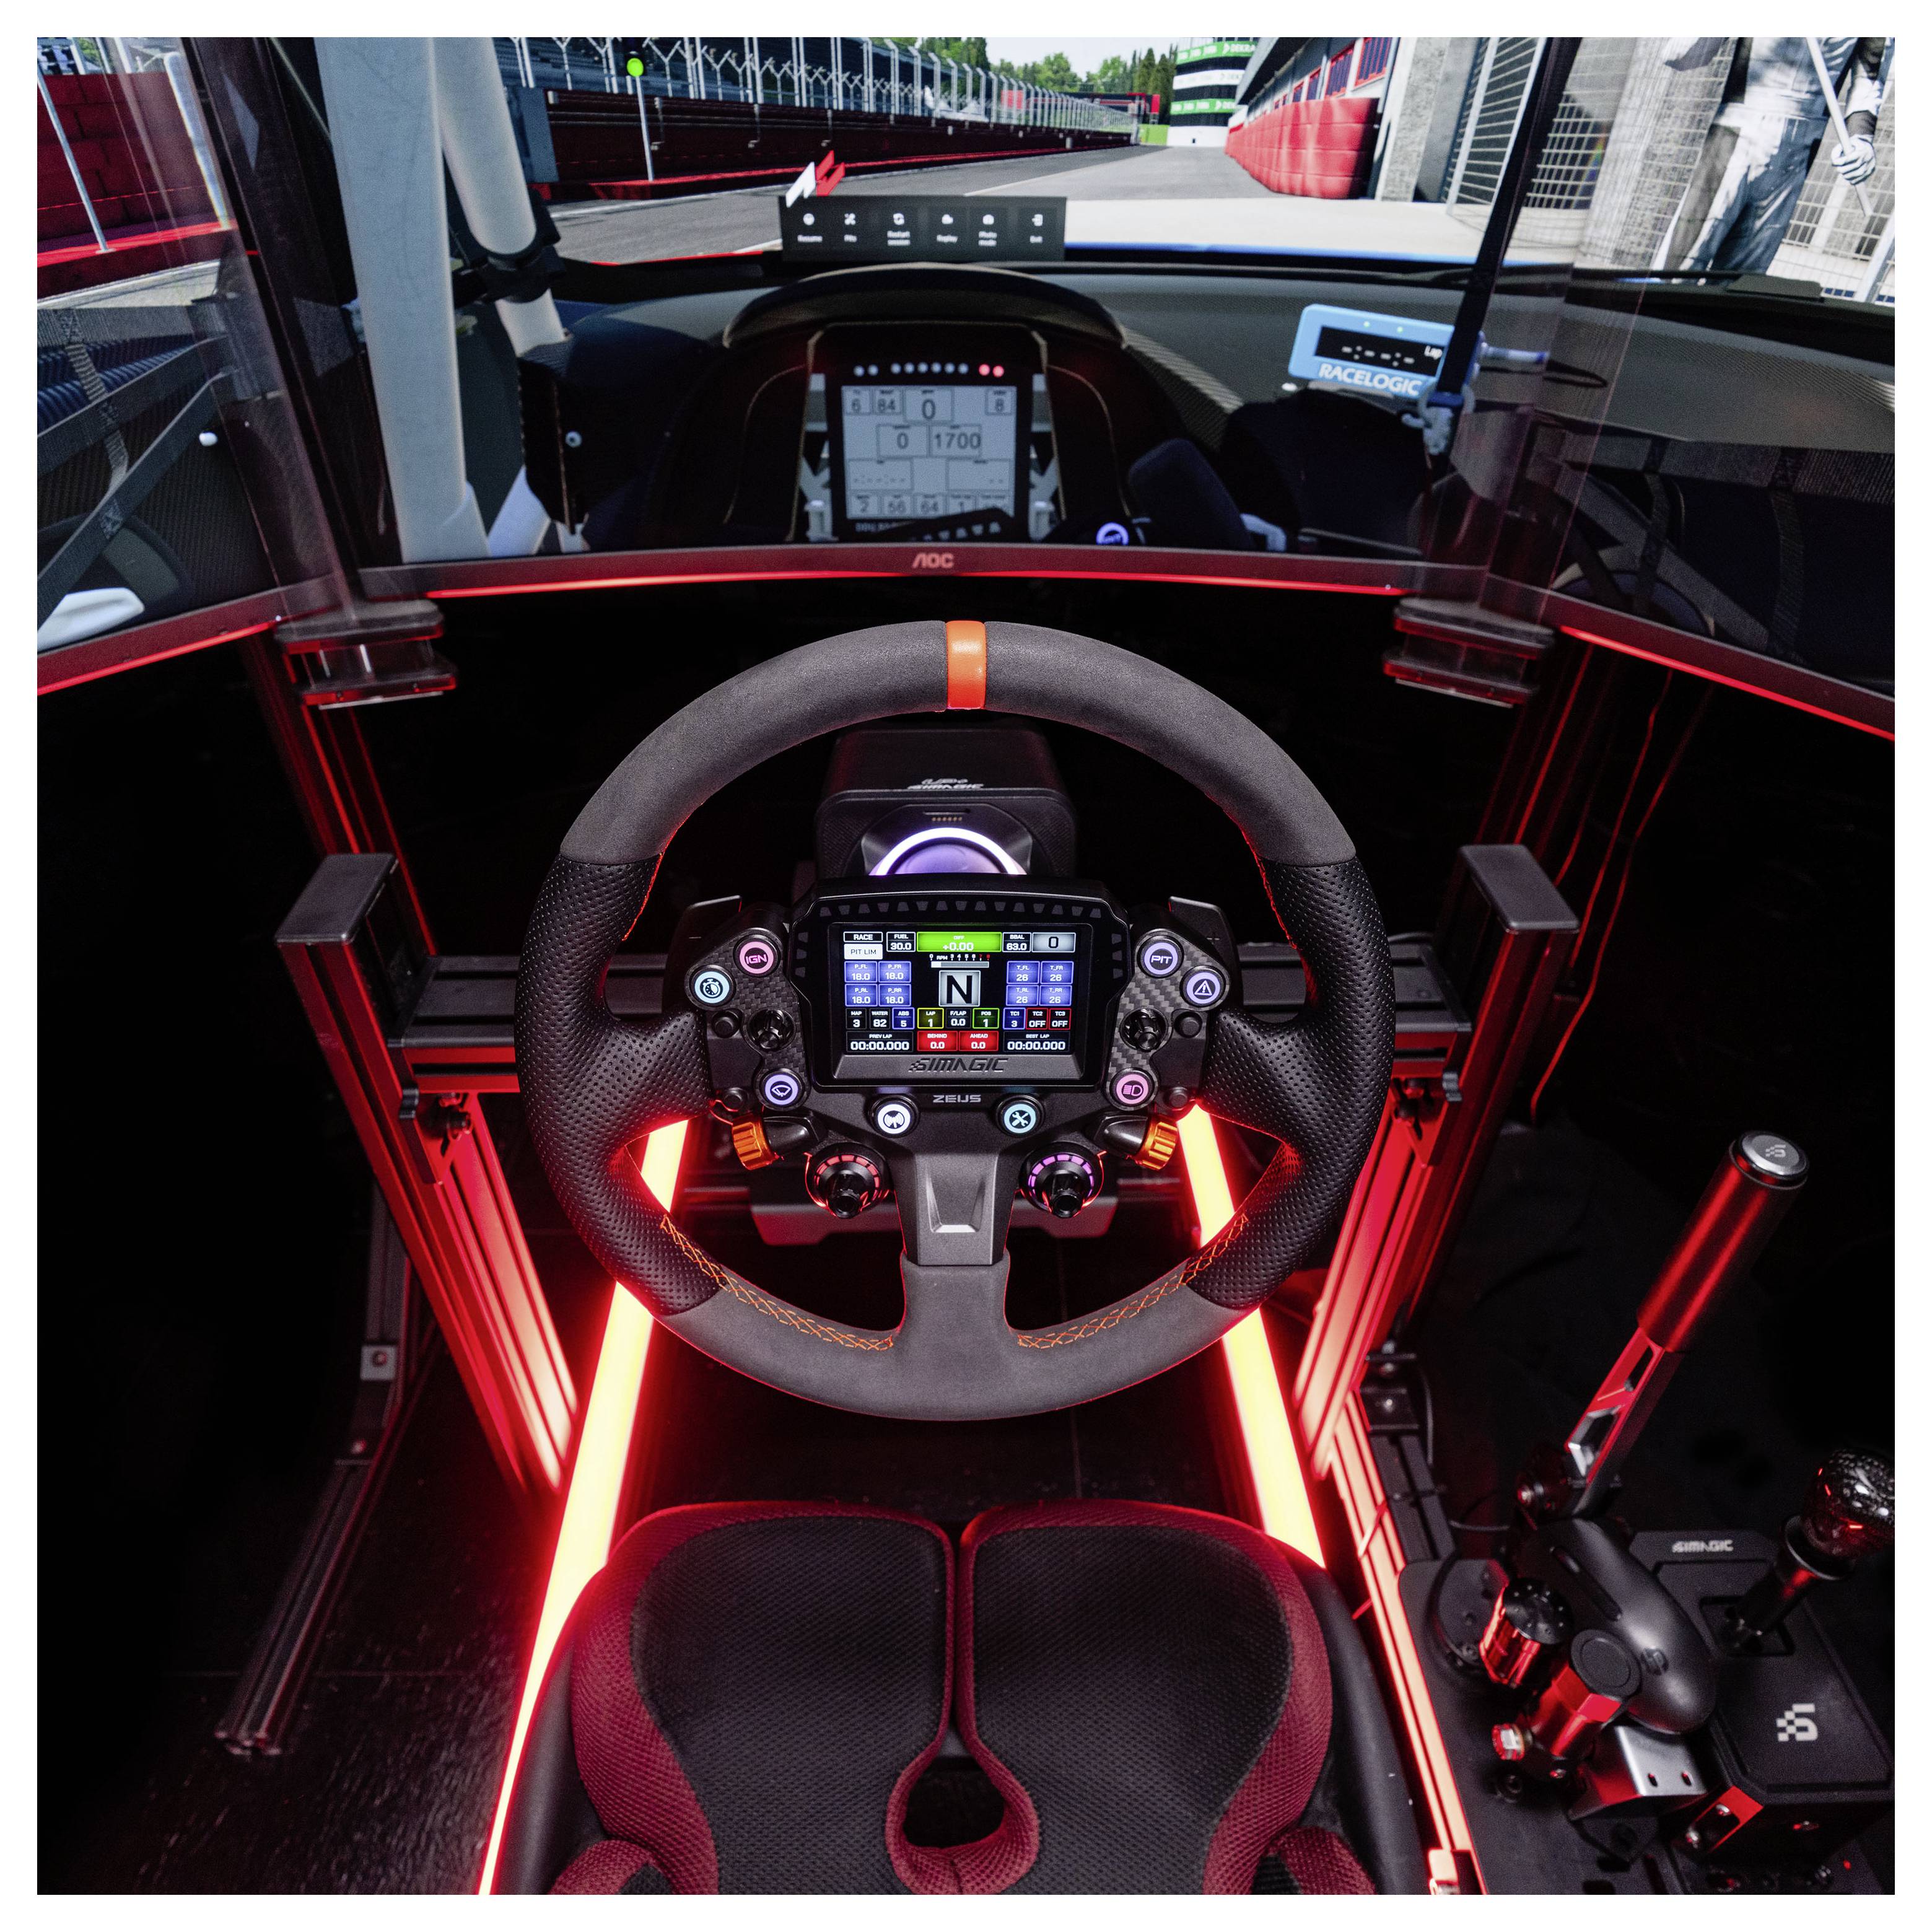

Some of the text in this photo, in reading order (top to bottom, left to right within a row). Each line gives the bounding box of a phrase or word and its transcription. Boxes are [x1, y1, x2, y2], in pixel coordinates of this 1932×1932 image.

[1318, 363, 1423, 396] RACELOGIC
[921, 398, 936, 421] 0
[897, 432, 909, 450] 0
[934, 432, 982, 450] 1700
[912, 553, 954, 569] AOC
[890, 942, 912, 950] 30.0
[942, 942, 974, 951] +0.00
[1048, 936, 1059, 948] 0
[1007, 943, 1027, 951] 63.0
[745, 954, 768, 964] IGN
[1151, 955, 1173, 964] PIT
[852, 973, 870, 981] 18.0
[885, 972, 904, 980] 18.0
[1016, 974, 1028, 982] 26
[1050, 974, 1062, 982] 26
[946, 975, 973, 1004] N
[852, 996, 871, 1004] 18.0
[885, 996, 904, 1004] 18.0
[852, 1019, 860, 1028] 3
[873, 1019, 887, 1028] 82
[928, 1019, 933, 1028] 1
[983, 1018, 989, 1028] 1
[850, 1041, 910, 1051] 00:00.000
[930, 1041, 945, 1049] 0.0
[971, 1041, 986, 1049] 0.0
[1007, 1041, 1065, 1051] 00:00.000
[909, 1058, 1009, 1072] SIMAGIC
[932, 1095, 982, 1103] ZEUS
